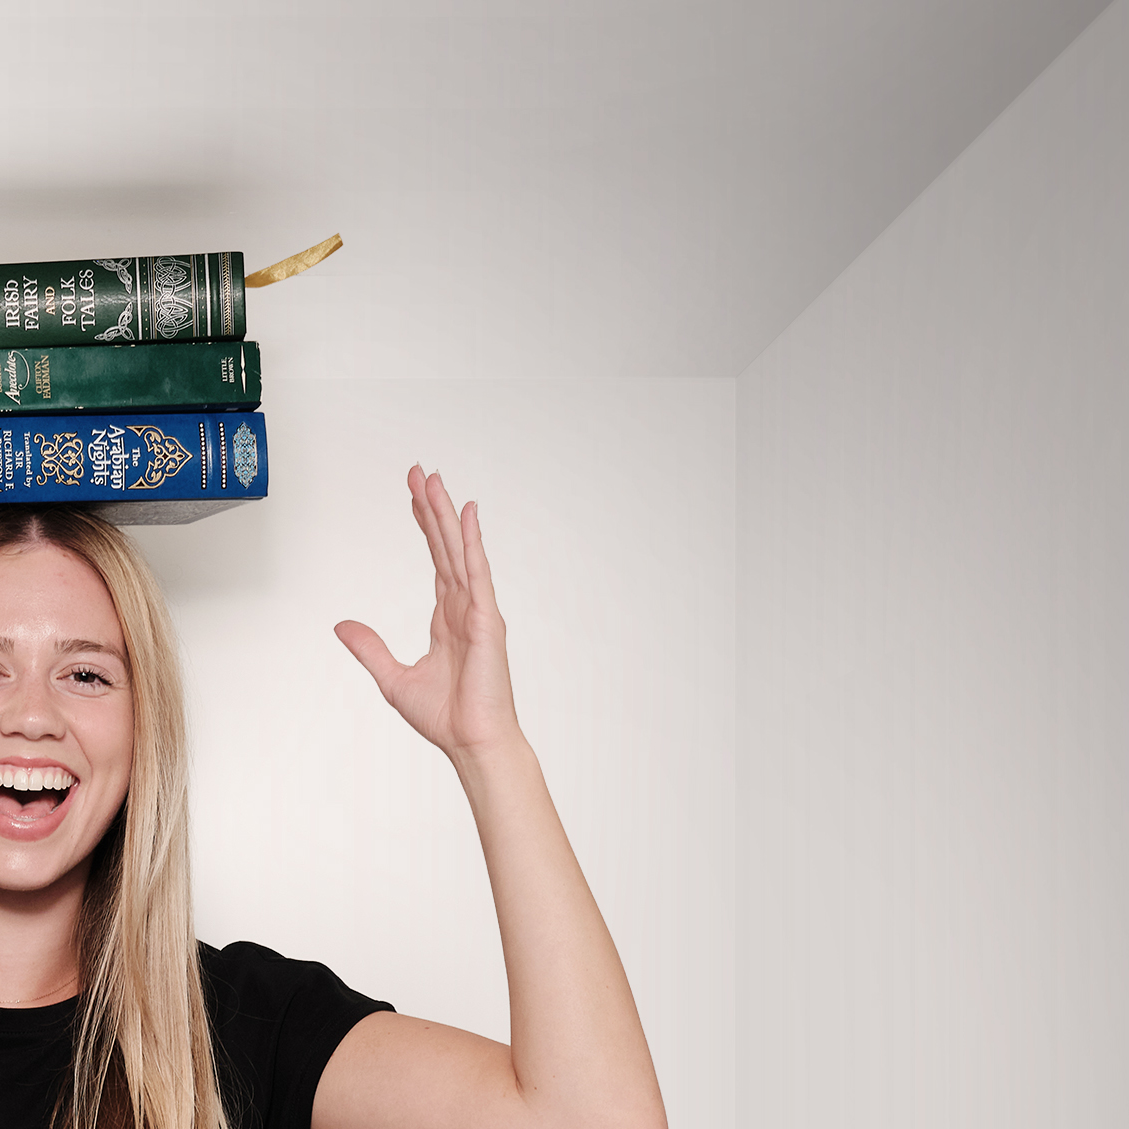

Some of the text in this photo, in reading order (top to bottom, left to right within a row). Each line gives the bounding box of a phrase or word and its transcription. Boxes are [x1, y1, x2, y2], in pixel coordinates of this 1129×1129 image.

[4, 279, 20, 328] IRISH
[23, 276, 39, 331] FAIRY
[45, 286, 56, 315] AND
[61, 276, 77, 326] FOLK
[79, 269, 96, 332] TALES
[4, 350, 28, 405] Anecdotes
[34, 361, 42, 394] CLIFTON
[41, 355, 51, 399] FADIMAN
[3, 430, 14, 491] RICHARD F.
[15, 451, 24, 470] SIR
[24, 432, 34, 488] Translated by
[88, 429, 109, 486] Nights
[107, 425, 129, 491] Arabian
[131, 447, 141, 467] The
